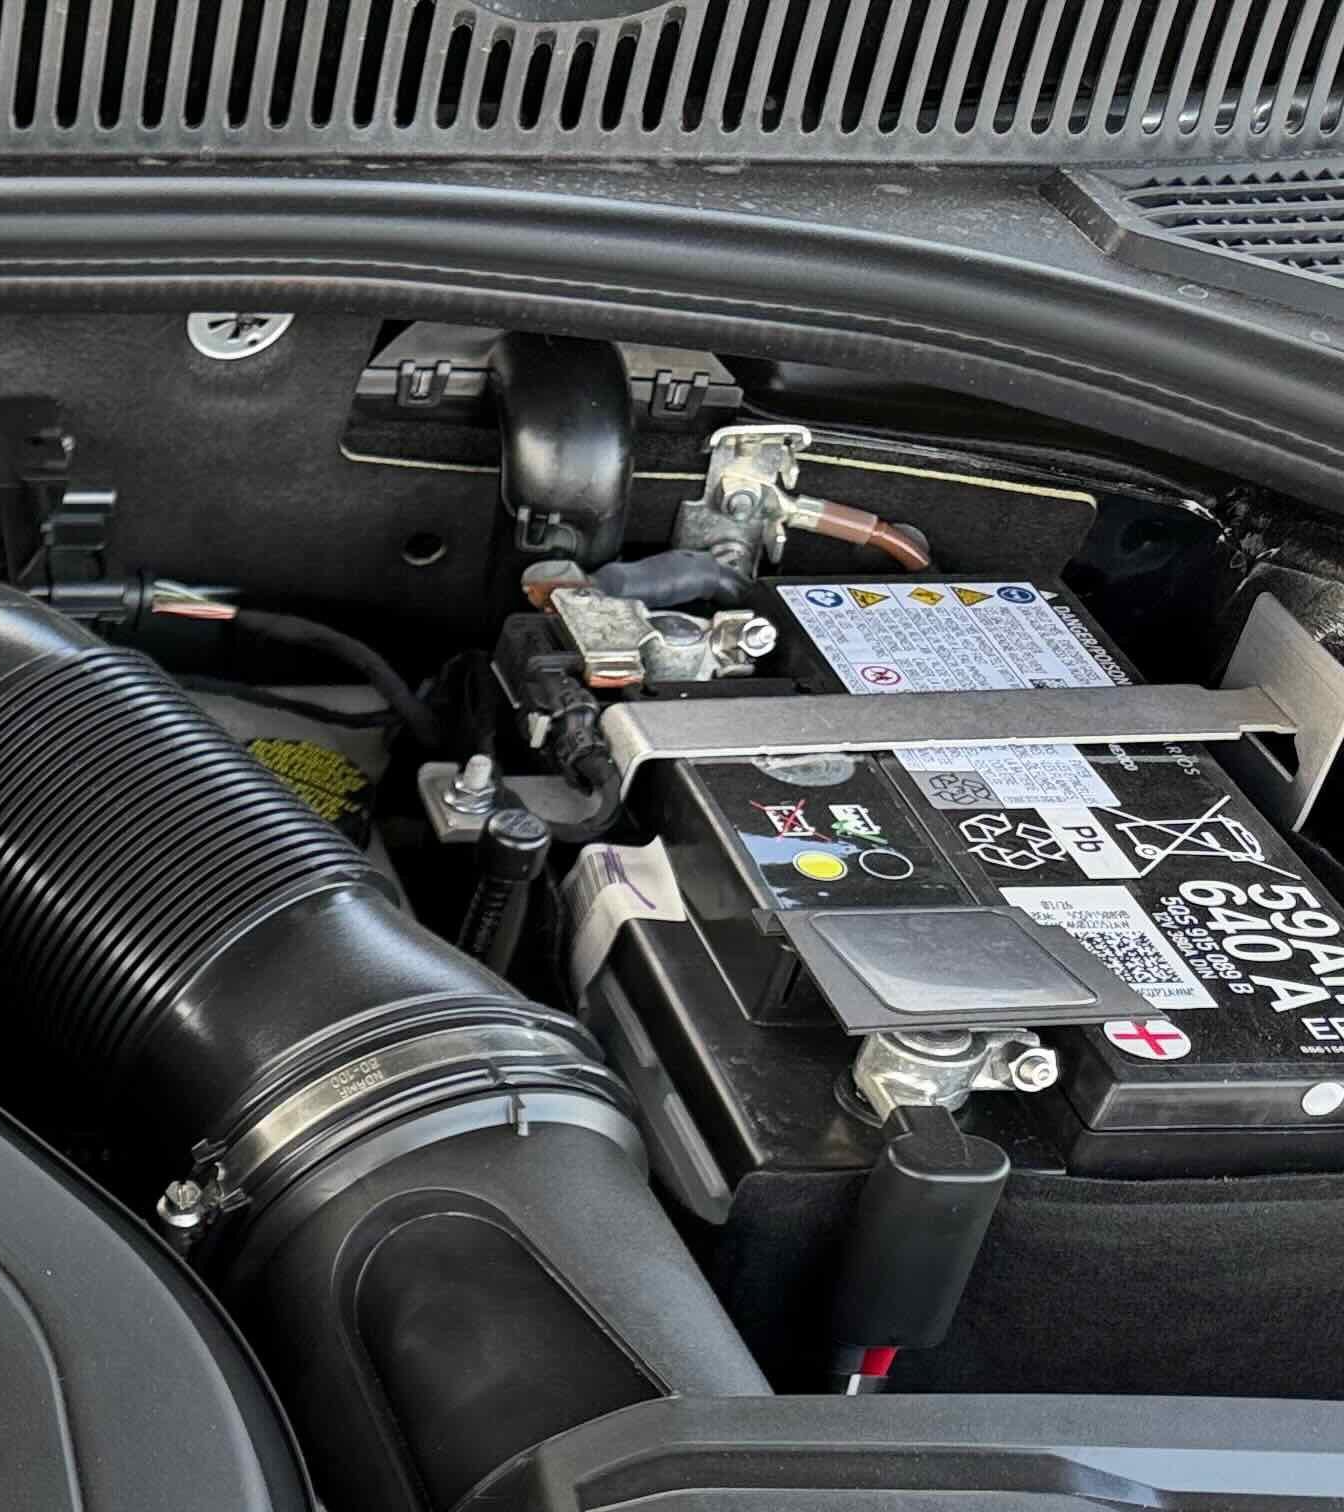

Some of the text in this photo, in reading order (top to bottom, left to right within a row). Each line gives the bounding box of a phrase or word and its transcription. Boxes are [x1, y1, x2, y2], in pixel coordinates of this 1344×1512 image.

[1062, 825, 1104, 853] Pb
[1179, 880, 1294, 962] 640
[1249, 975, 1331, 1013] A
[1186, 927, 1219, 952] 915
[1206, 954, 1242, 980] 089
[1228, 982, 1255, 995] B
[1191, 959, 1219, 980] DIN
